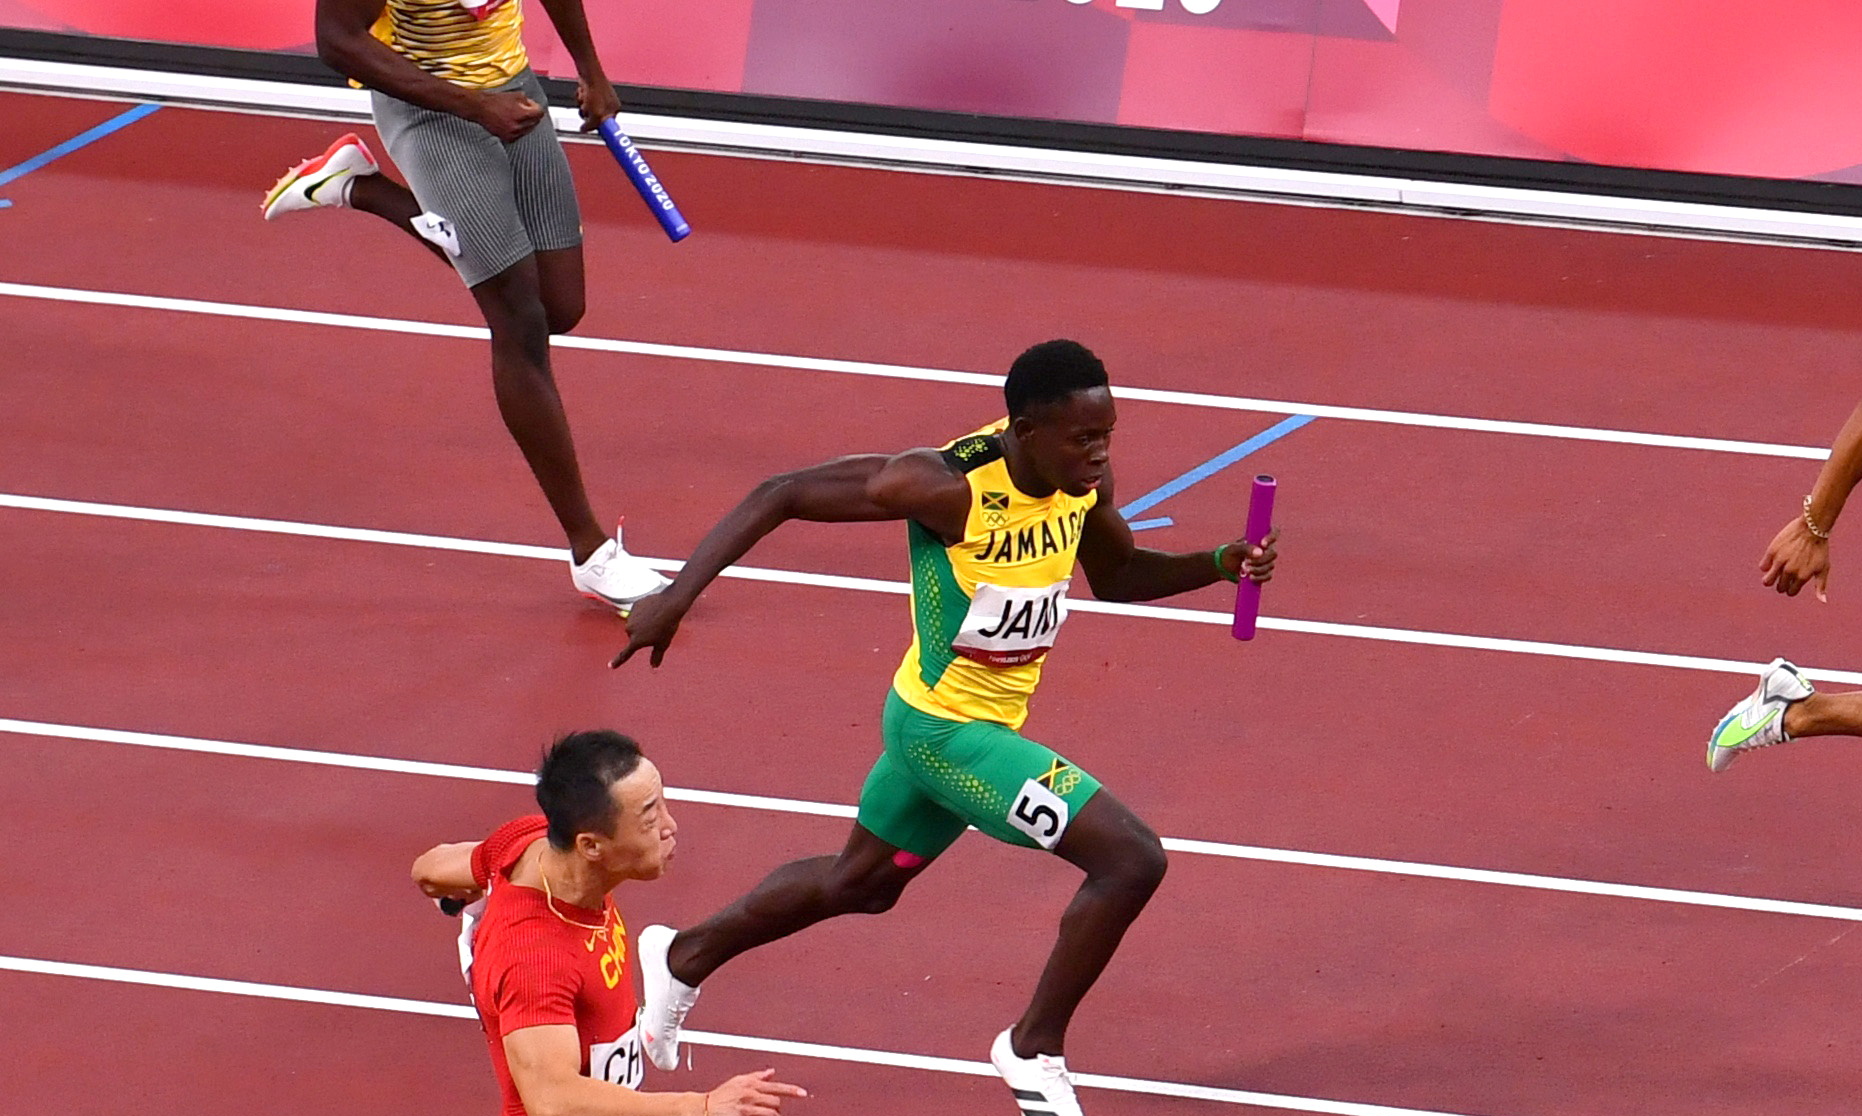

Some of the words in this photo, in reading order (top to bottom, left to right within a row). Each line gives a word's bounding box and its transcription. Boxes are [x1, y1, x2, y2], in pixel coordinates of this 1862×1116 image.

[614, 129, 650, 175] TOKYO
[645, 174, 675, 211] 2020
[977, 589, 1060, 639] JAM
[1015, 795, 1059, 837] 5
